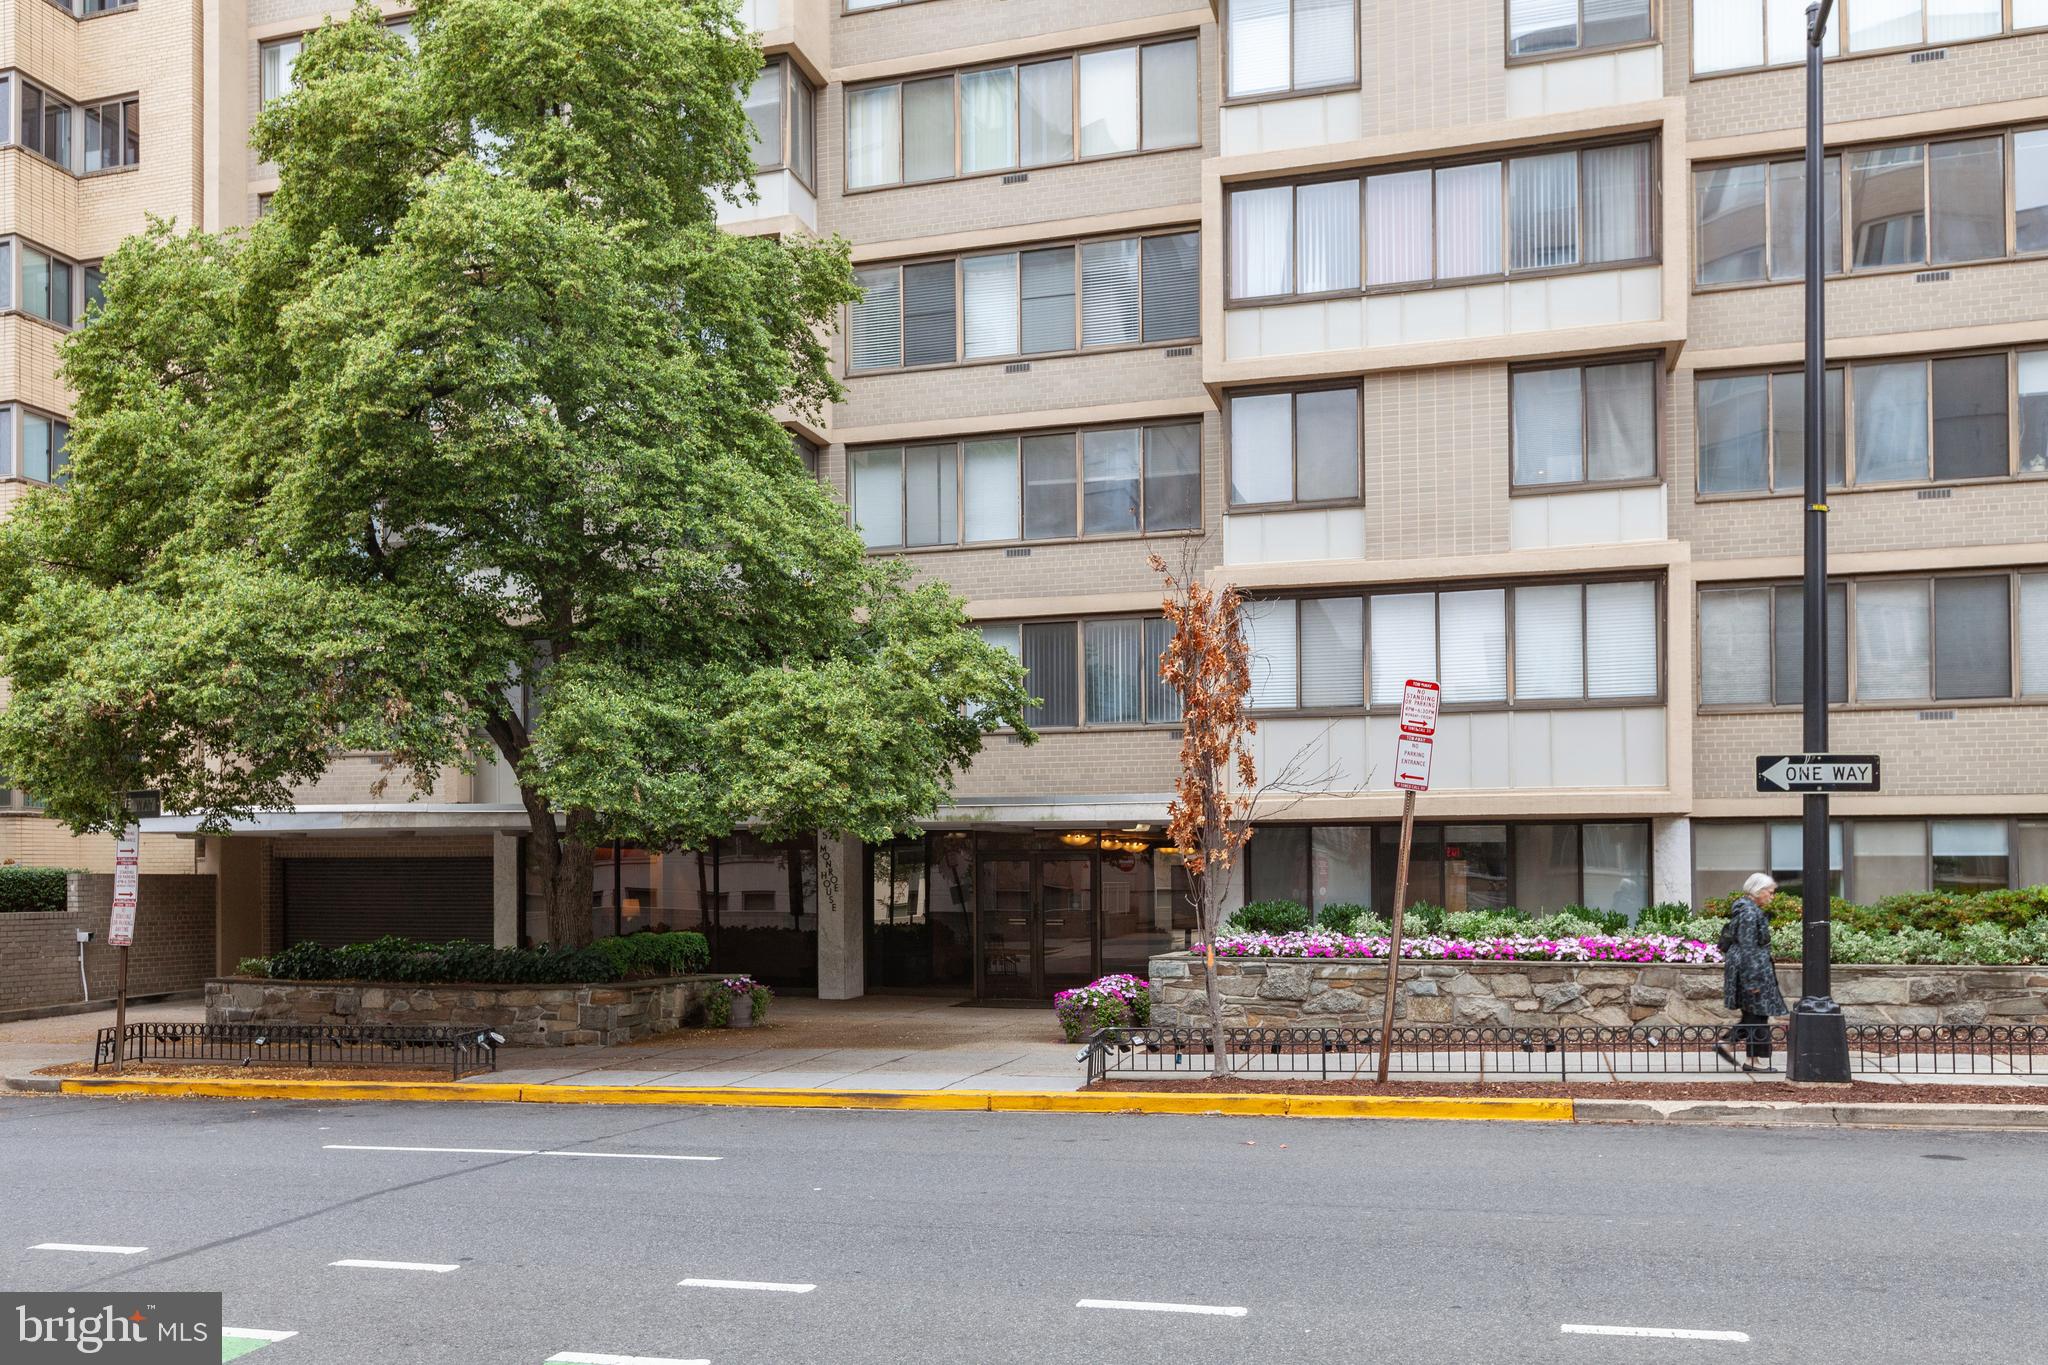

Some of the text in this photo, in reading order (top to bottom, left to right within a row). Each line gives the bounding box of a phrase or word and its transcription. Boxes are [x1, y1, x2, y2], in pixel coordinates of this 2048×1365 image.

[1406, 693, 1436, 702] STANDING
[1414, 700, 1435, 708] PARKING
[1403, 751, 1425, 759] PARKING
[1401, 758, 1426, 767] ENTRANCE
[1785, 766, 1869, 781] ONE WAY
[820, 845, 838, 892] MONROE
[821, 872, 837, 912] HOUSE
